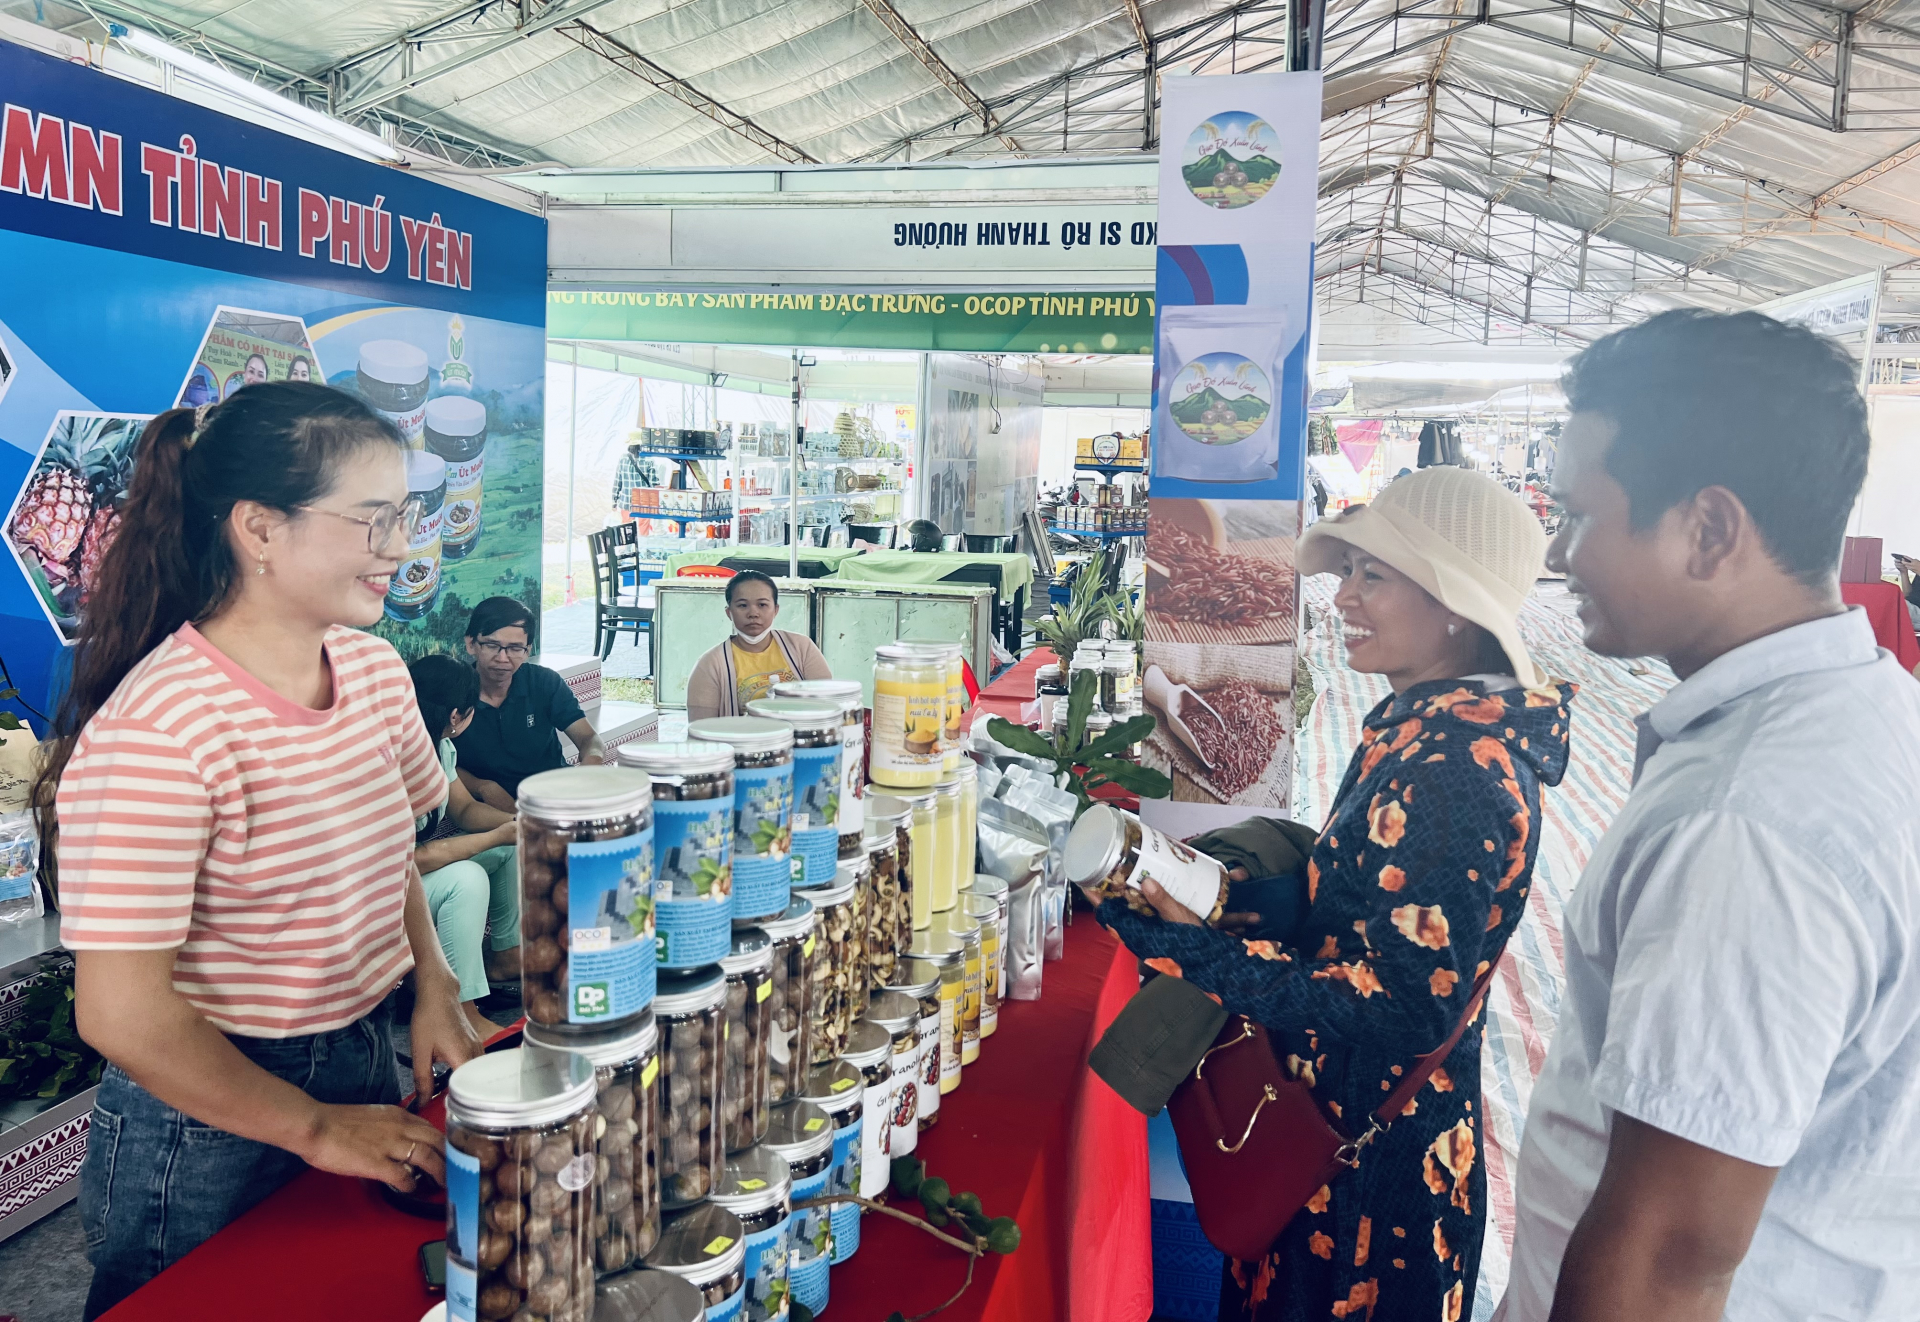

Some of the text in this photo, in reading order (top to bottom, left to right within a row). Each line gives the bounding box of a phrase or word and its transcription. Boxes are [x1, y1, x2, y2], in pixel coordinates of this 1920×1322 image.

[0, 103, 473, 291] MN TỈNH PHÚ YÊN
[976, 222, 1051, 246] THANH
[869, 294, 946, 315] TRƯNG
[964, 296, 1026, 316] OCOP
[1089, 292, 1140, 318] PHÚ
[578, 986, 606, 1008] DP
